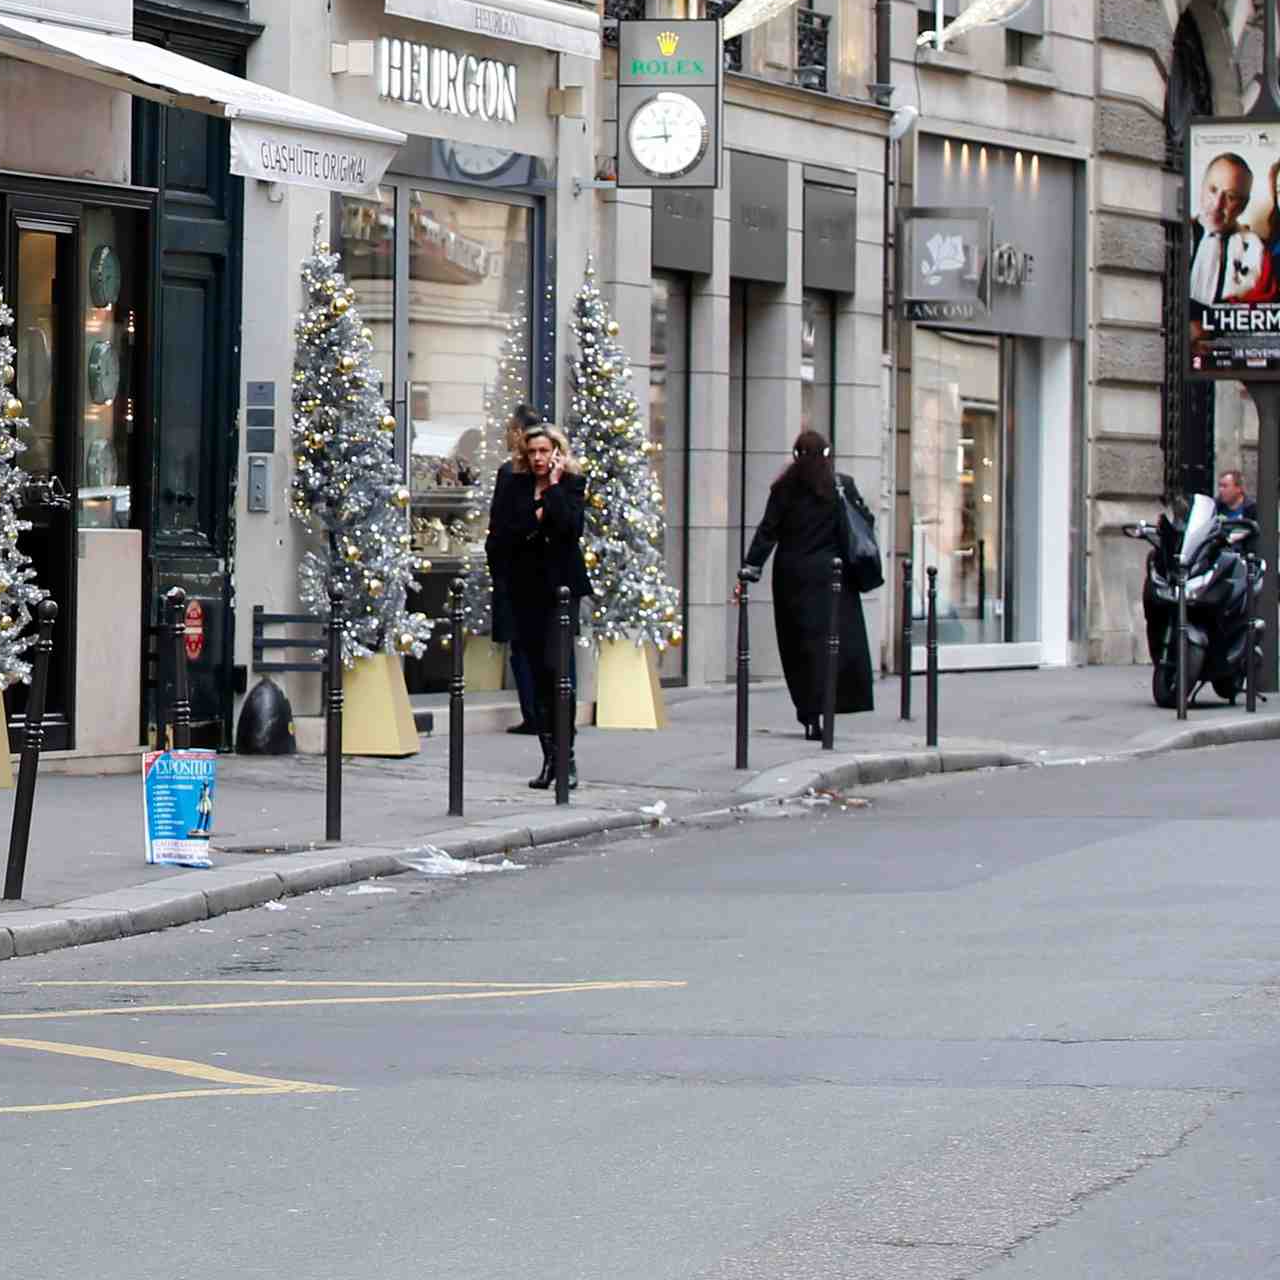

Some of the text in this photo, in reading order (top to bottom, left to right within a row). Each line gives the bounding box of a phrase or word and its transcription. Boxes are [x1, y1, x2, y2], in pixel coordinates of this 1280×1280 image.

[379, 35, 518, 125] HEURGON
[631, 59, 705, 77] ROLEX
[259, 141, 368, 184] GLASHÜTTE ORIGINAL
